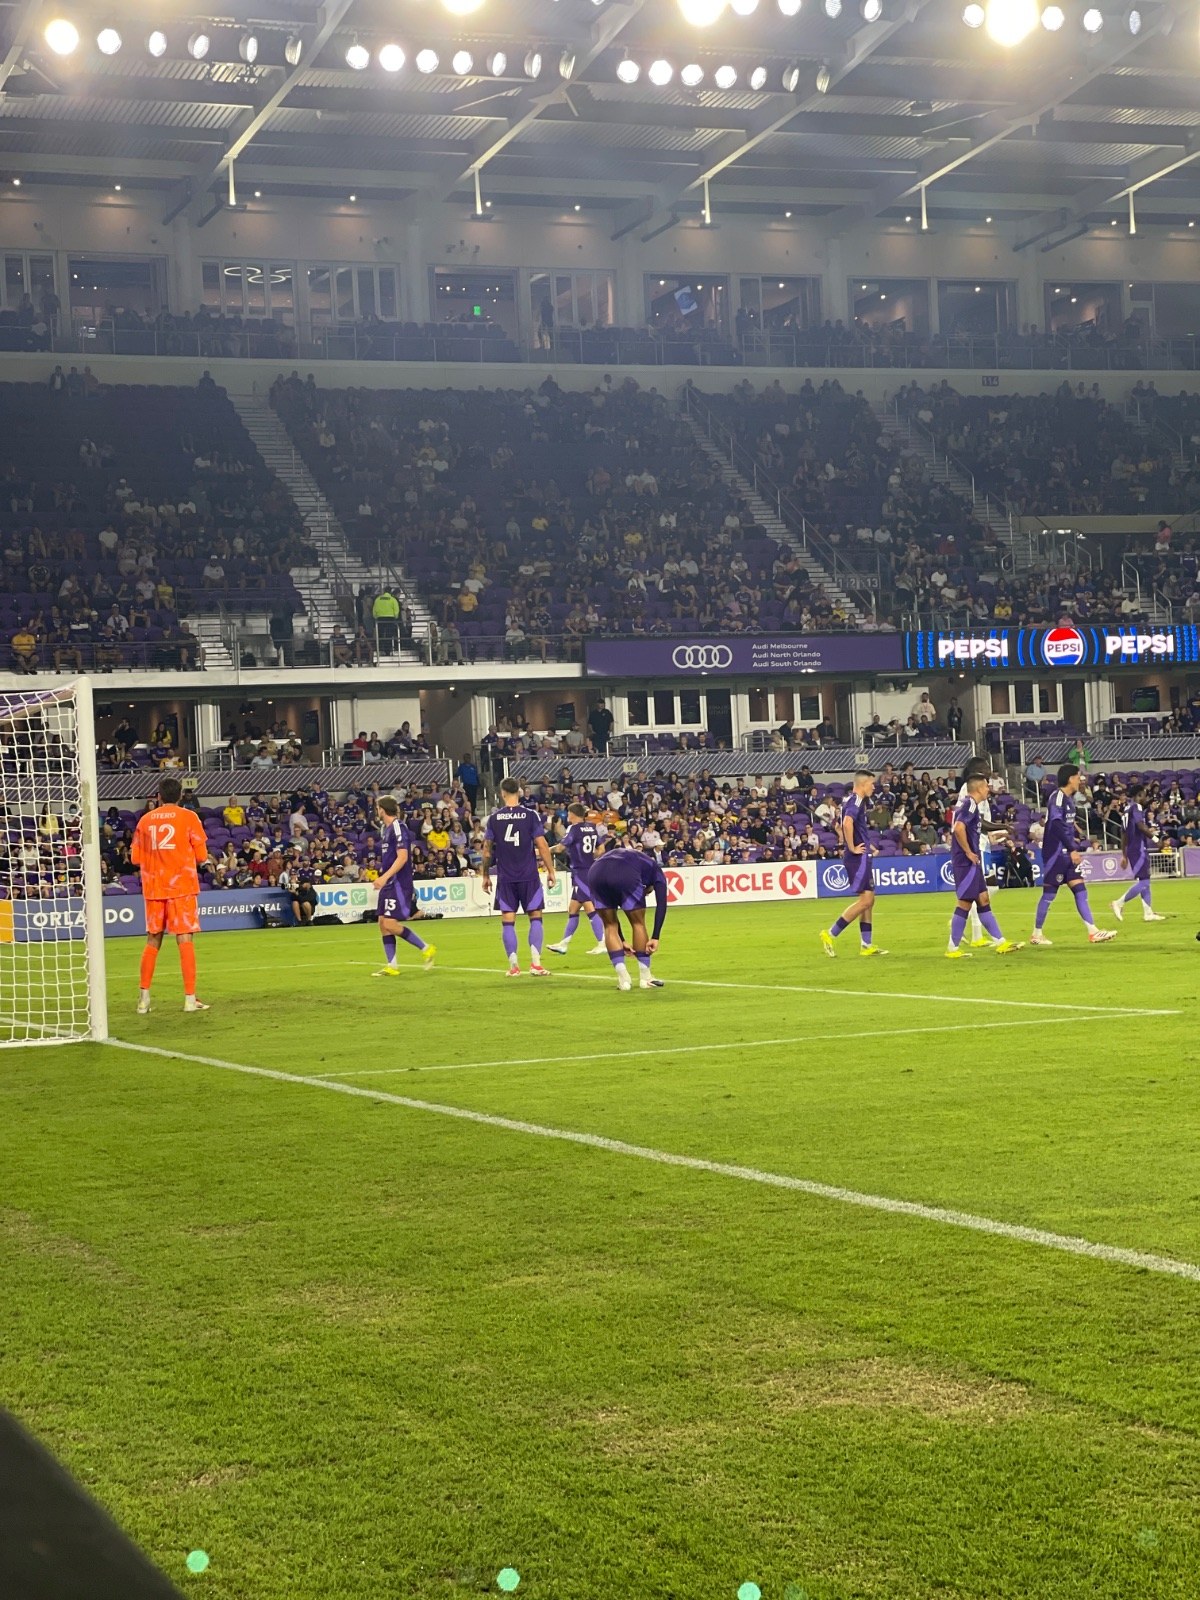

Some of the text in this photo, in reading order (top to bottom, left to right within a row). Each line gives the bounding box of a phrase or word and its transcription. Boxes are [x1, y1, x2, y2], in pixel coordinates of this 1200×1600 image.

[938, 638, 1009, 659] PEPSI
[1047, 643, 1081, 653] PEPSI
[1105, 634, 1174, 655] PEPSI
[150, 812, 176, 820] OTERO
[497, 812, 526, 820] BREKALO
[148, 824, 176, 850] 12
[504, 824, 520, 846] 4
[582, 834, 598, 854] 87
[700, 870, 806, 894] CIRCLE K
[873, 868, 926, 887] llstate
[316, 891, 348, 906] UC
[384, 898, 397, 911] 13
[32, 908, 134, 928] ORLADO
[197, 904, 256, 916] BELIEVABLY
